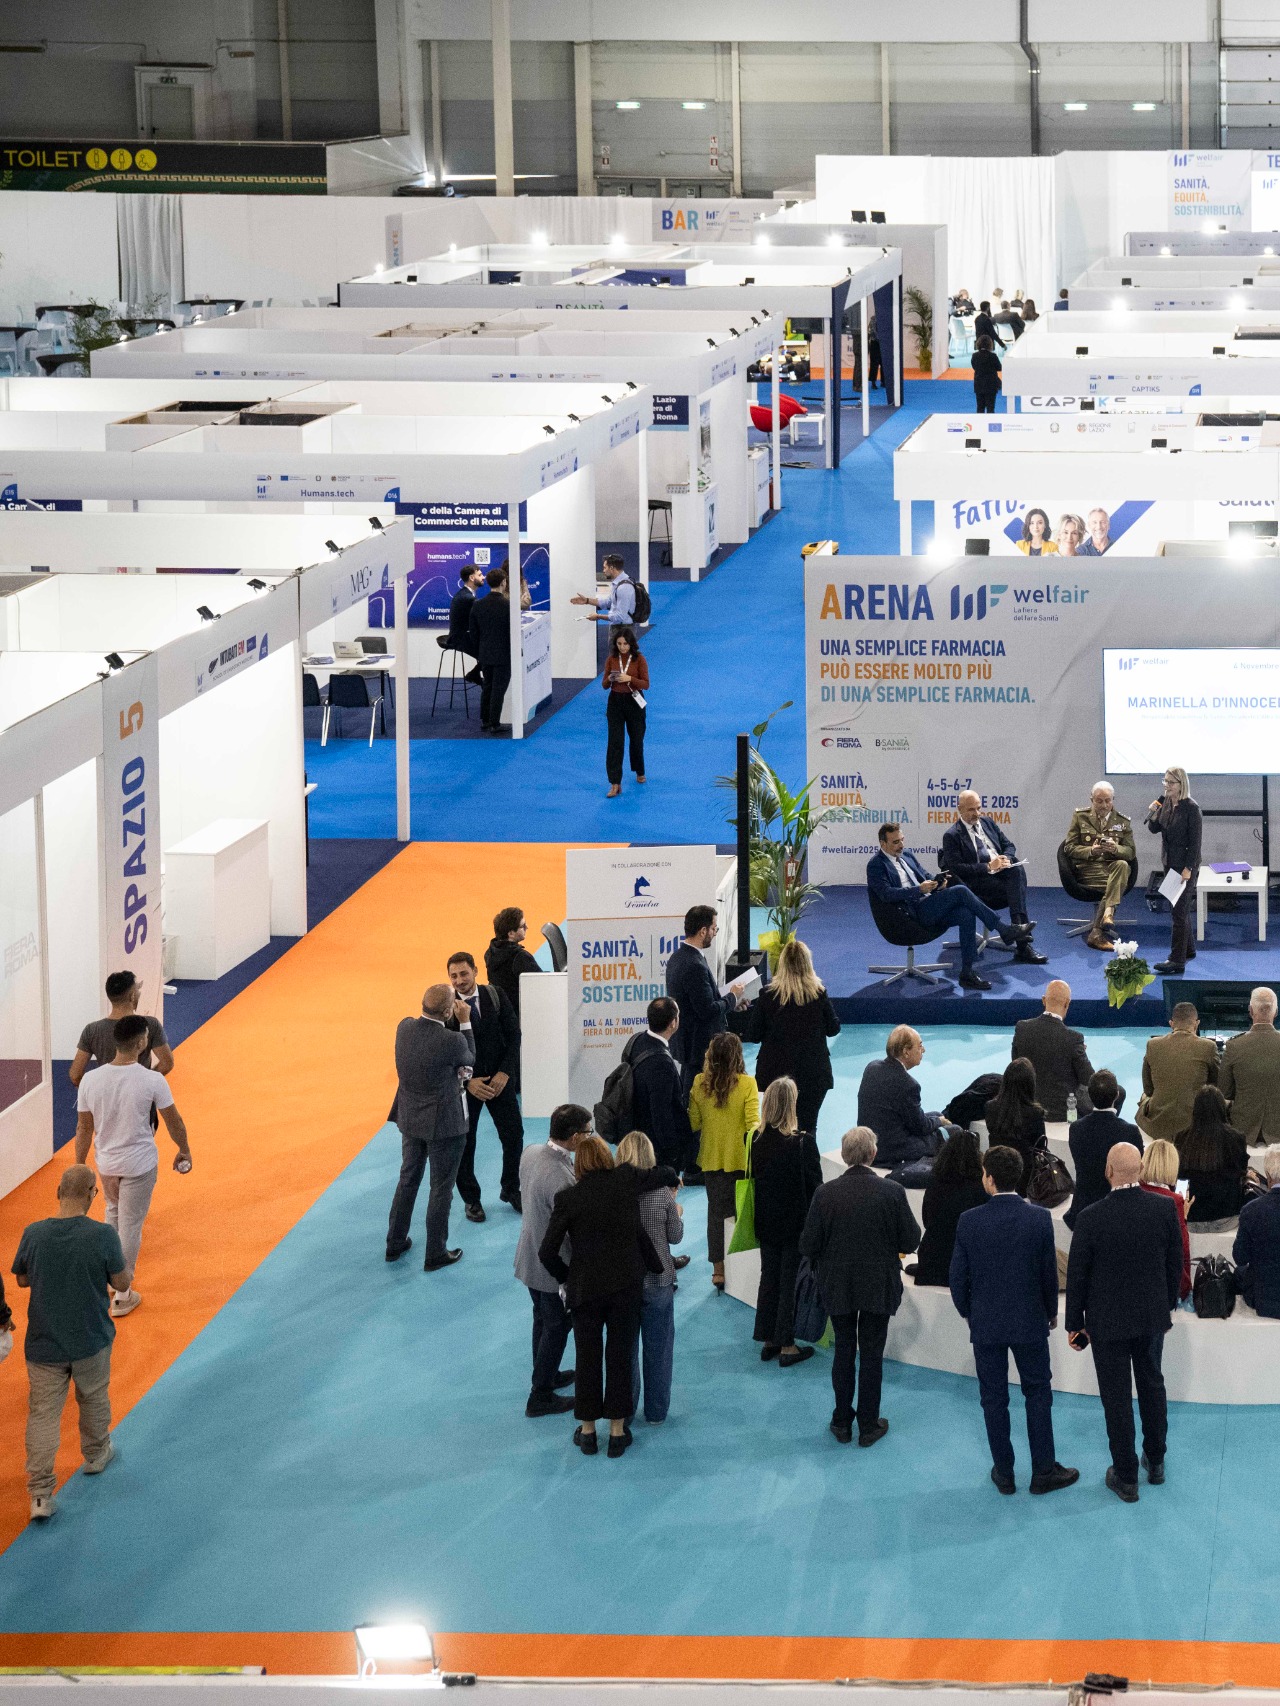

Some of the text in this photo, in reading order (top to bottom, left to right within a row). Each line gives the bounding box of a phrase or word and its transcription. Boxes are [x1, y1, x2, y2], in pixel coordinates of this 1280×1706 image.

[3, 150, 82, 168] TOILET
[1174, 176, 1210, 189] SANITÀ,
[1174, 190, 1209, 203] EQUITÀ,
[1174, 203, 1244, 215] SOSTENIBILITÀ.
[662, 210, 699, 230] BAR
[1131, 385, 1161, 393] CAPTIKS
[665, 404, 673, 412] di
[656, 413, 678, 421] Roma
[300, 489, 355, 498] Humans.tech
[46, 502, 56, 511] di
[429, 507, 453, 515] della
[454, 507, 490, 515] Camera
[491, 507, 501, 515] di
[415, 517, 508, 526] Commercio di Roma
[820, 584, 934, 621] ARENA
[1013, 584, 1090, 604] welfair
[1038, 613, 1059, 621] Sanità
[820, 639, 1007, 657] UNA SEMPLICE FARMACIA
[1142, 657, 1169, 665] welfair
[1240, 662, 1280, 670] Novembre
[820, 658, 992, 680] PUÒ ESSERE MOLTO PIÙ
[821, 685, 1036, 704] DI UNA SEMPLICE FARMACIA.
[1127, 696, 1208, 709] MARINELLA
[821, 772, 868, 790] SANITÀ,
[926, 778, 972, 791] 4-5-6-7
[821, 789, 867, 807] EQUITÀ,
[927, 796, 1019, 808] NOVEE 2025
[927, 811, 959, 824] FIERA
[119, 700, 148, 955] SPAZIO 5
[822, 846, 879, 854] #welfair2025
[4, 931, 35, 962] FIERA
[581, 935, 644, 959] SANITÀ,
[4, 945, 38, 979] ROMA
[582, 958, 642, 981] EQUITÀ,
[582, 983, 668, 1003] SOSTENIBI
[583, 1019, 597, 1027] DAL
[598, 1018, 603, 1026] 4
[604, 1018, 614, 1026] AL
[621, 1017, 649, 1026] NOVEMB
[583, 1026, 634, 1037] FIERA DI ROMA
